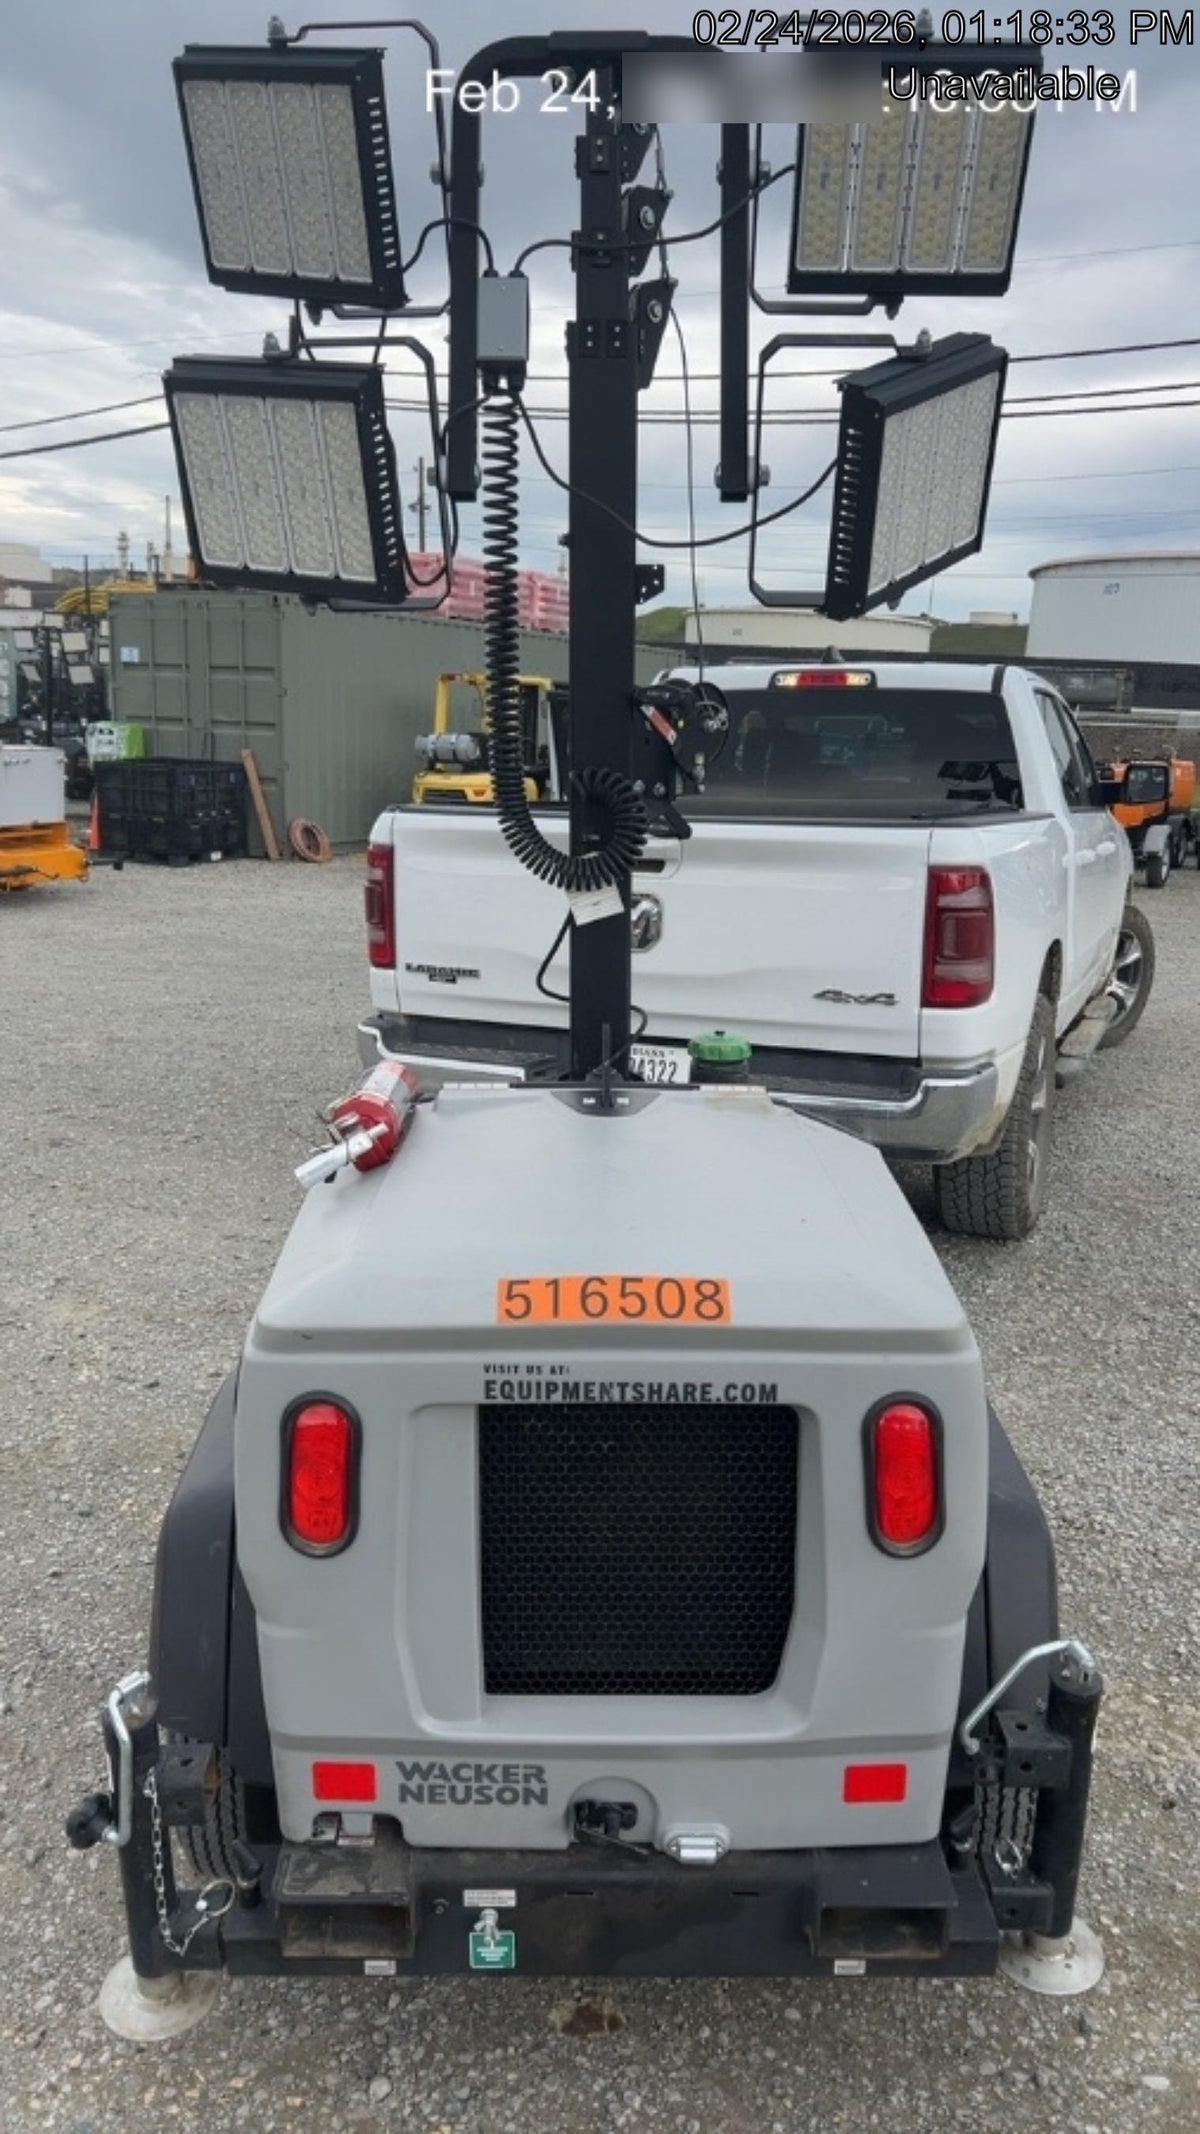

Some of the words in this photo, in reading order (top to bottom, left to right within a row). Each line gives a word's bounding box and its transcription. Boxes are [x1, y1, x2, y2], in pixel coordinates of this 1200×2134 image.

[504, 1277, 725, 1321] 516508
[483, 1363, 519, 1375] VISIT
[526, 1364, 543, 1376] US
[484, 1379, 779, 1403] EQUIPMENTSHARE.COM
[396, 1761, 547, 1784] WACKER
[398, 1783, 549, 1806] NEUSON
